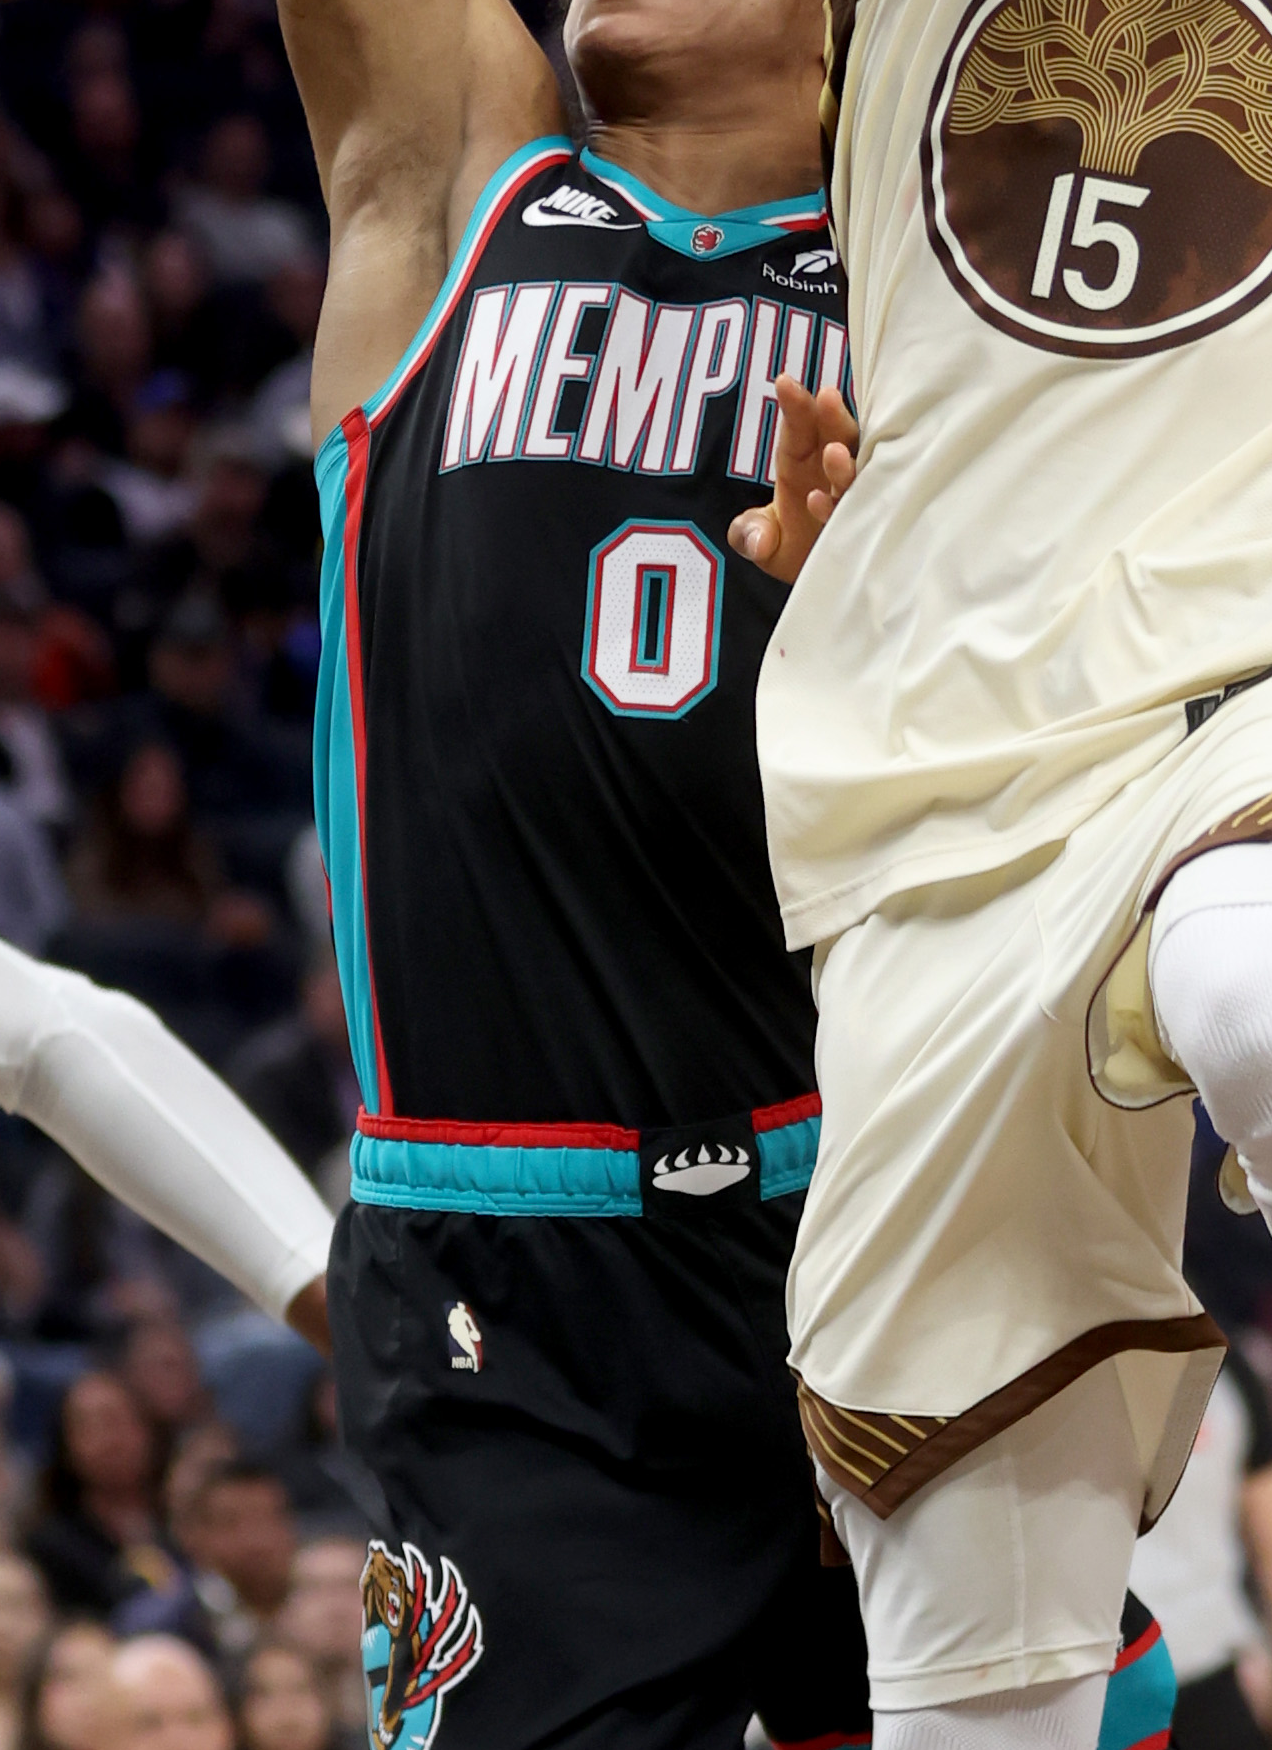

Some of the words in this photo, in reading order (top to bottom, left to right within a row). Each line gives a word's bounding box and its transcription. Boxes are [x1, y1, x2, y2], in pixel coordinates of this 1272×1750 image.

[541, 184, 620, 225] NIKE
[1030, 172, 1151, 311] 15
[439, 281, 860, 488] MEMPH
[581, 519, 725, 719] 0
[451, 1356, 473, 1369] NBA
